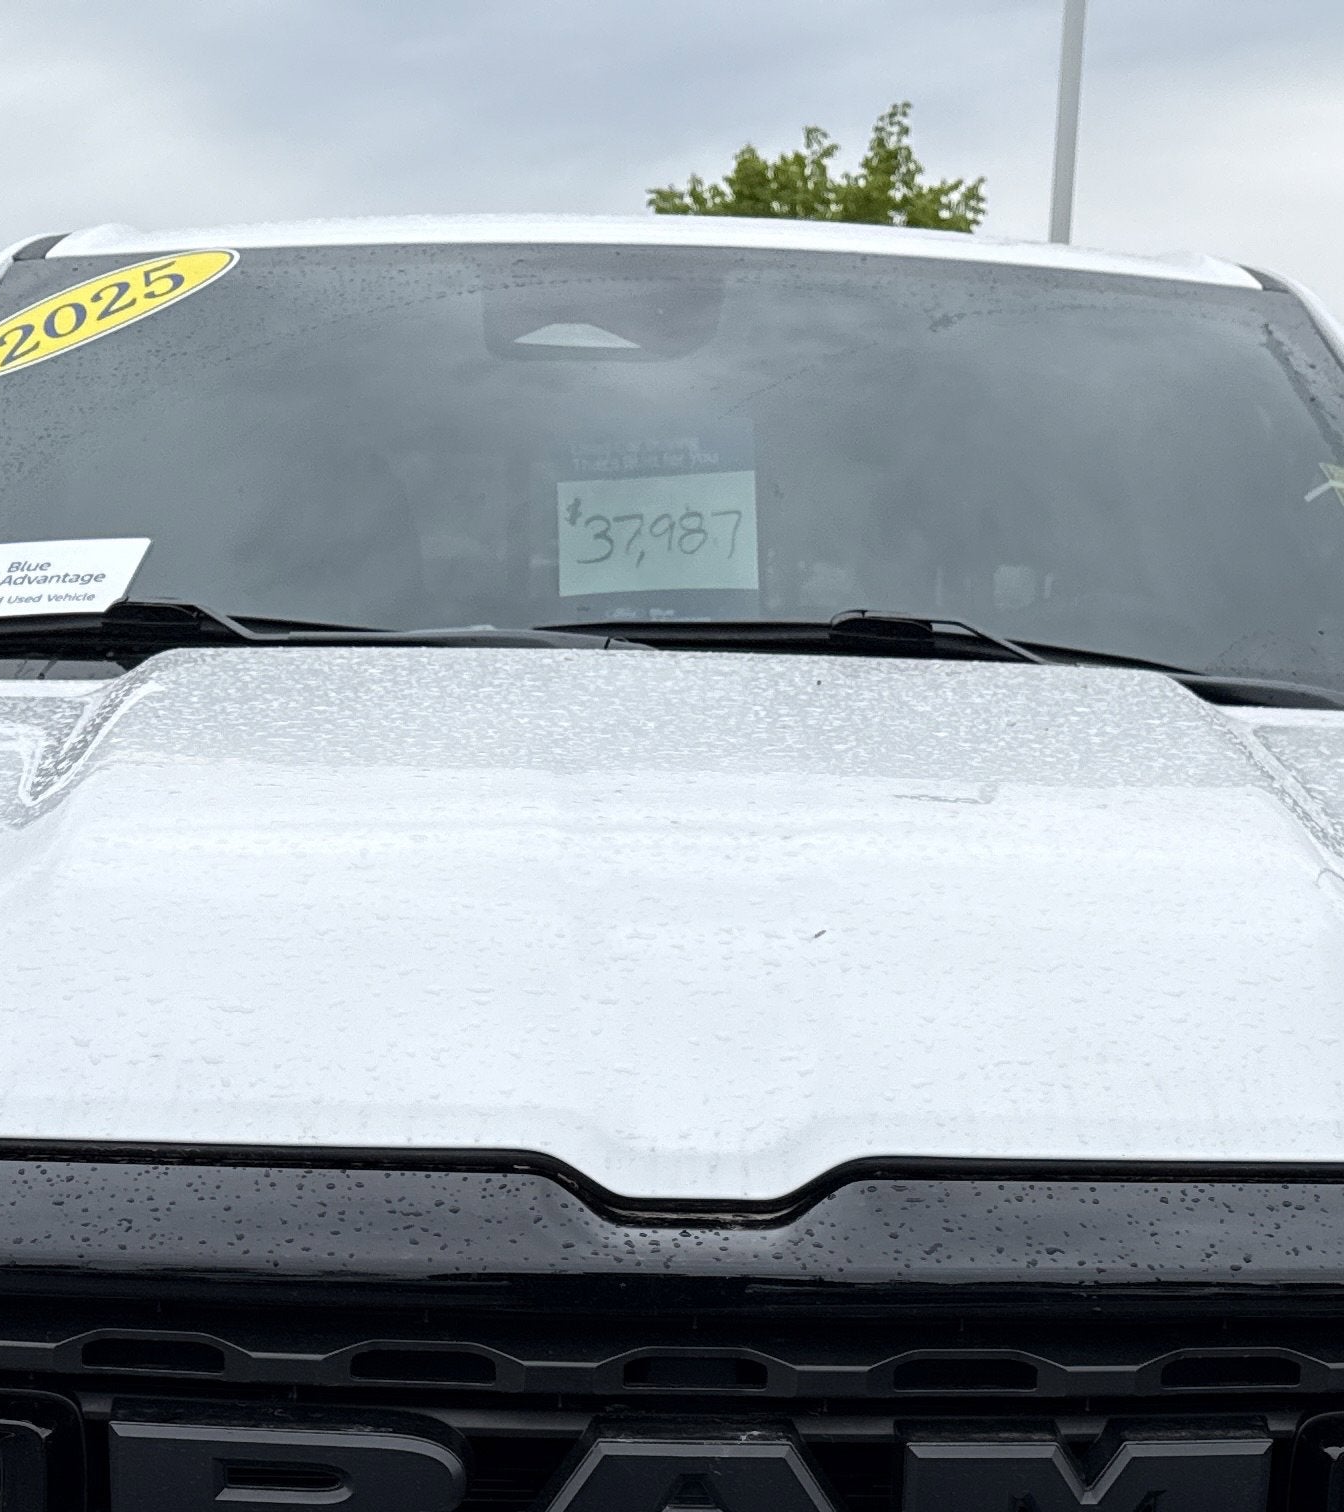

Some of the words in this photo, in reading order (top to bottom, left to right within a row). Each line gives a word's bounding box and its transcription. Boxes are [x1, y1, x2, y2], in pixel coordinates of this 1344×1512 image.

[565, 498, 743, 568] $37,987
[7, 560, 52, 573] Blue
[7, 593, 42, 604] Used
[47, 592, 96, 603] Vehicle
